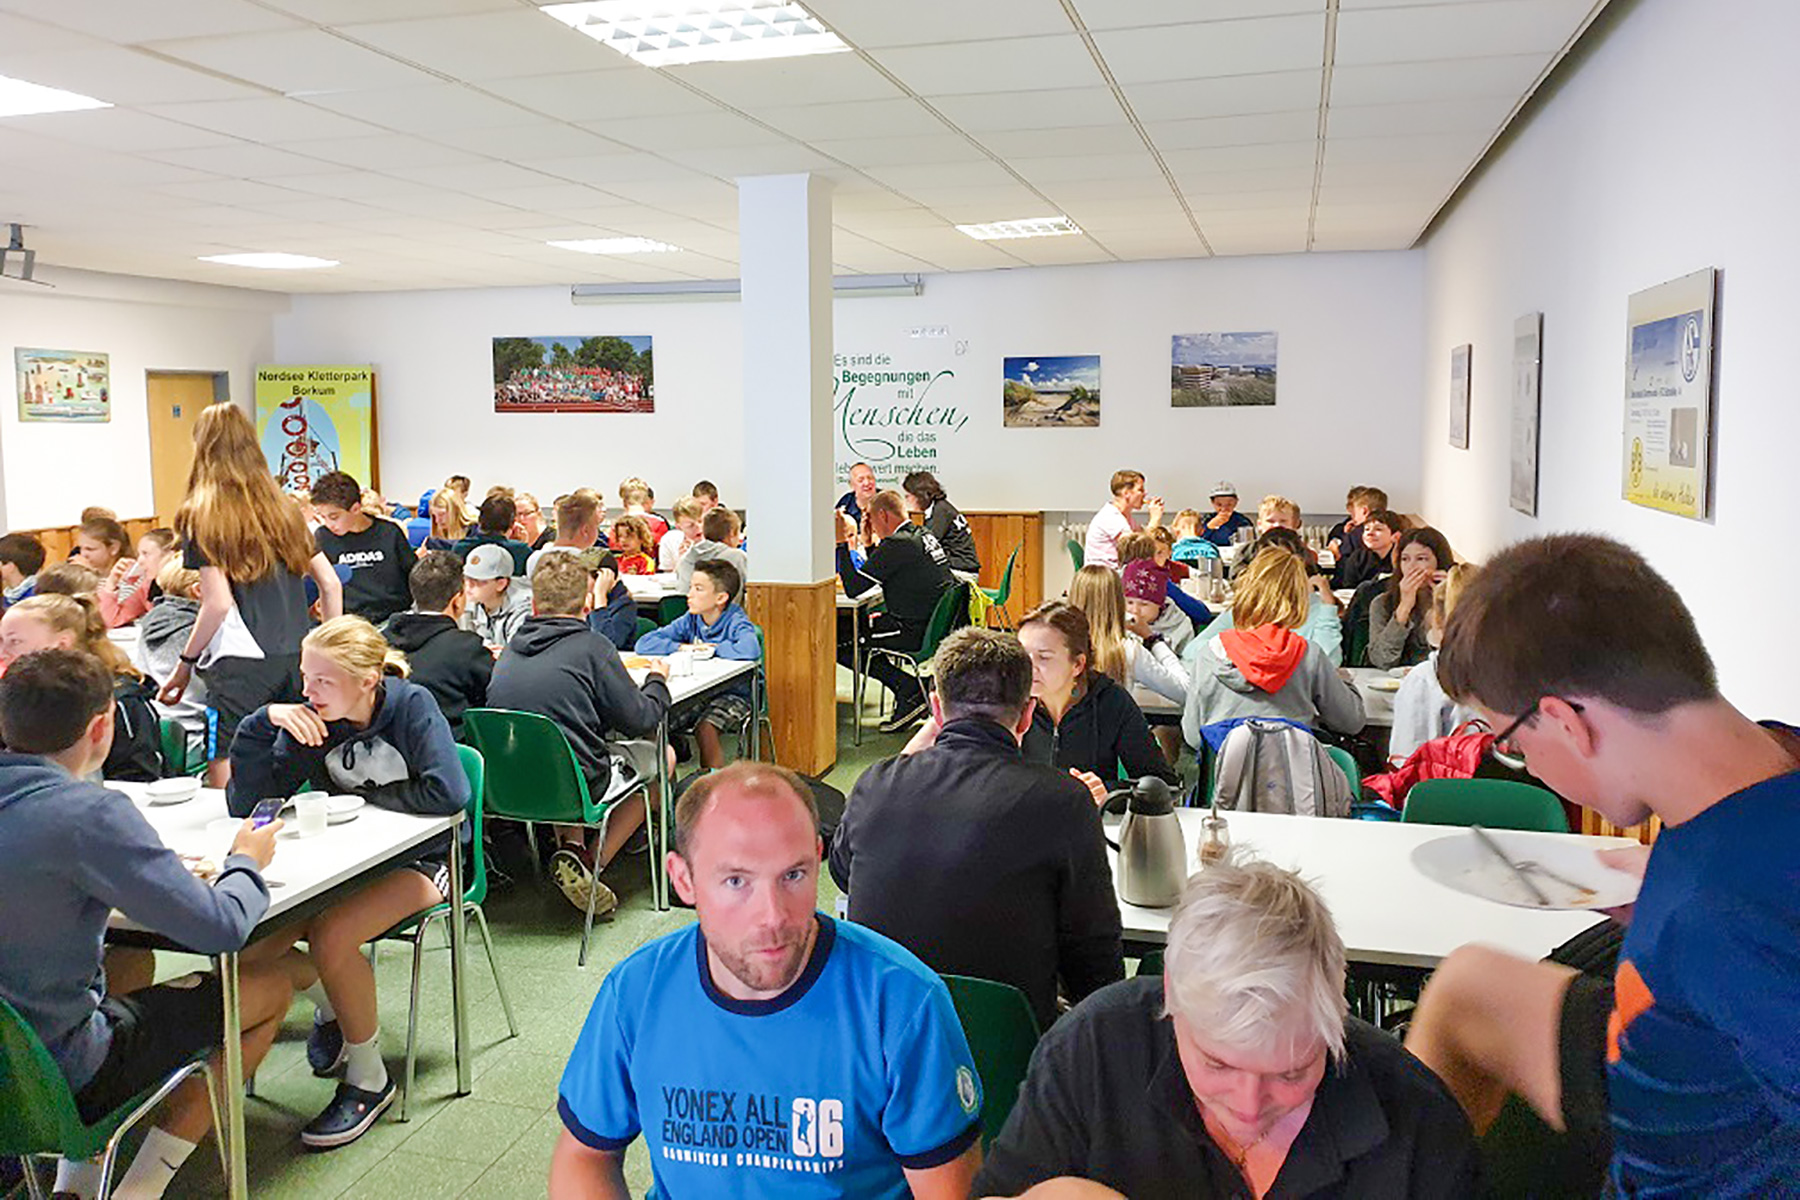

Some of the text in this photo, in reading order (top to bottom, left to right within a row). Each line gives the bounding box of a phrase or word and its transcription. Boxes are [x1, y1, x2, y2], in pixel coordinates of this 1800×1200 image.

[834, 353, 891, 366] Es sind die
[258, 370, 368, 383] Nordsee Kletterpark
[842, 369, 931, 387] Begegnungen
[292, 385, 336, 396] Borkum
[897, 386, 914, 399] mit
[897, 430, 937, 443] die das
[897, 445, 937, 459] Leben
[338, 550, 385, 565] ADIDAS
[662, 1086, 737, 1122] YONEX
[745, 1093, 788, 1129] ALL
[662, 1120, 788, 1154] ENGLAND OPEN
